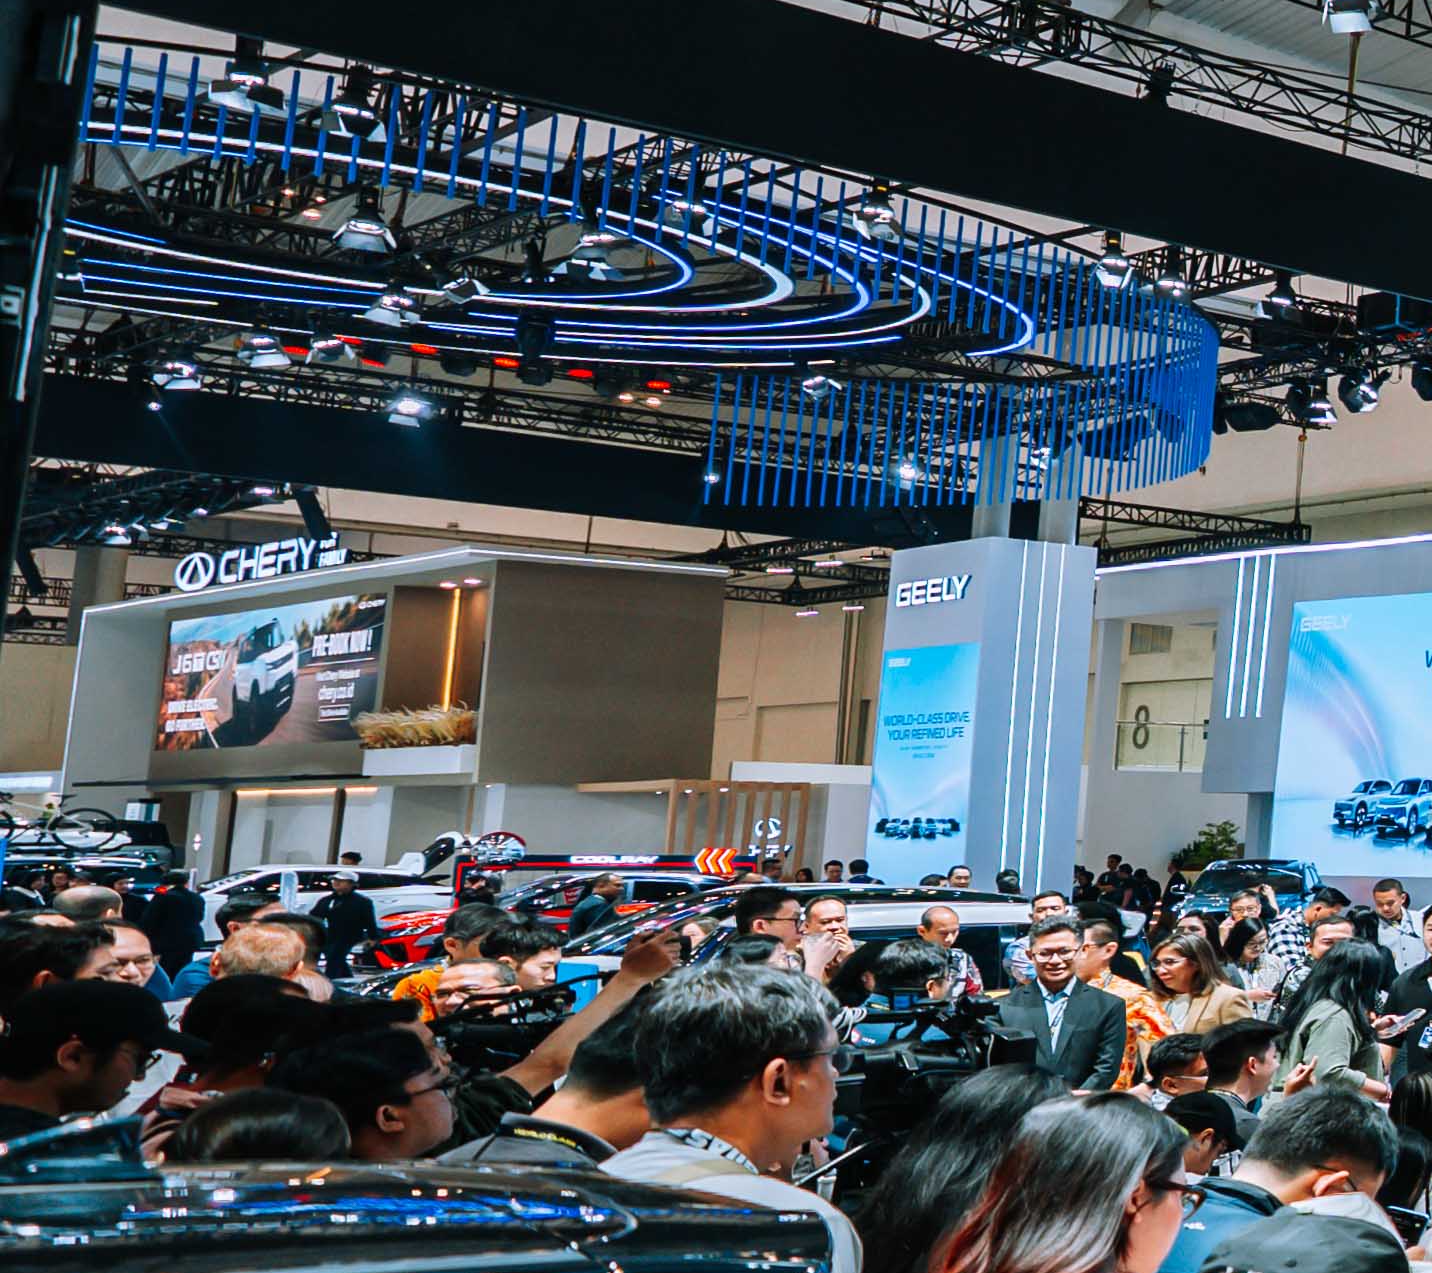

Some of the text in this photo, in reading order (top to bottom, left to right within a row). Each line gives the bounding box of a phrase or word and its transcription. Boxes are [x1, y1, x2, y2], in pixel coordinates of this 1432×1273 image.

[219, 537, 317, 584] CHERY
[896, 574, 969, 608] GEELY
[1300, 615, 1350, 632] GEELY
[883, 713, 943, 726] WORLD-CLASS
[1132, 704, 1150, 749] 8
[888, 726, 964, 742] YOUR REFINED LIFE
